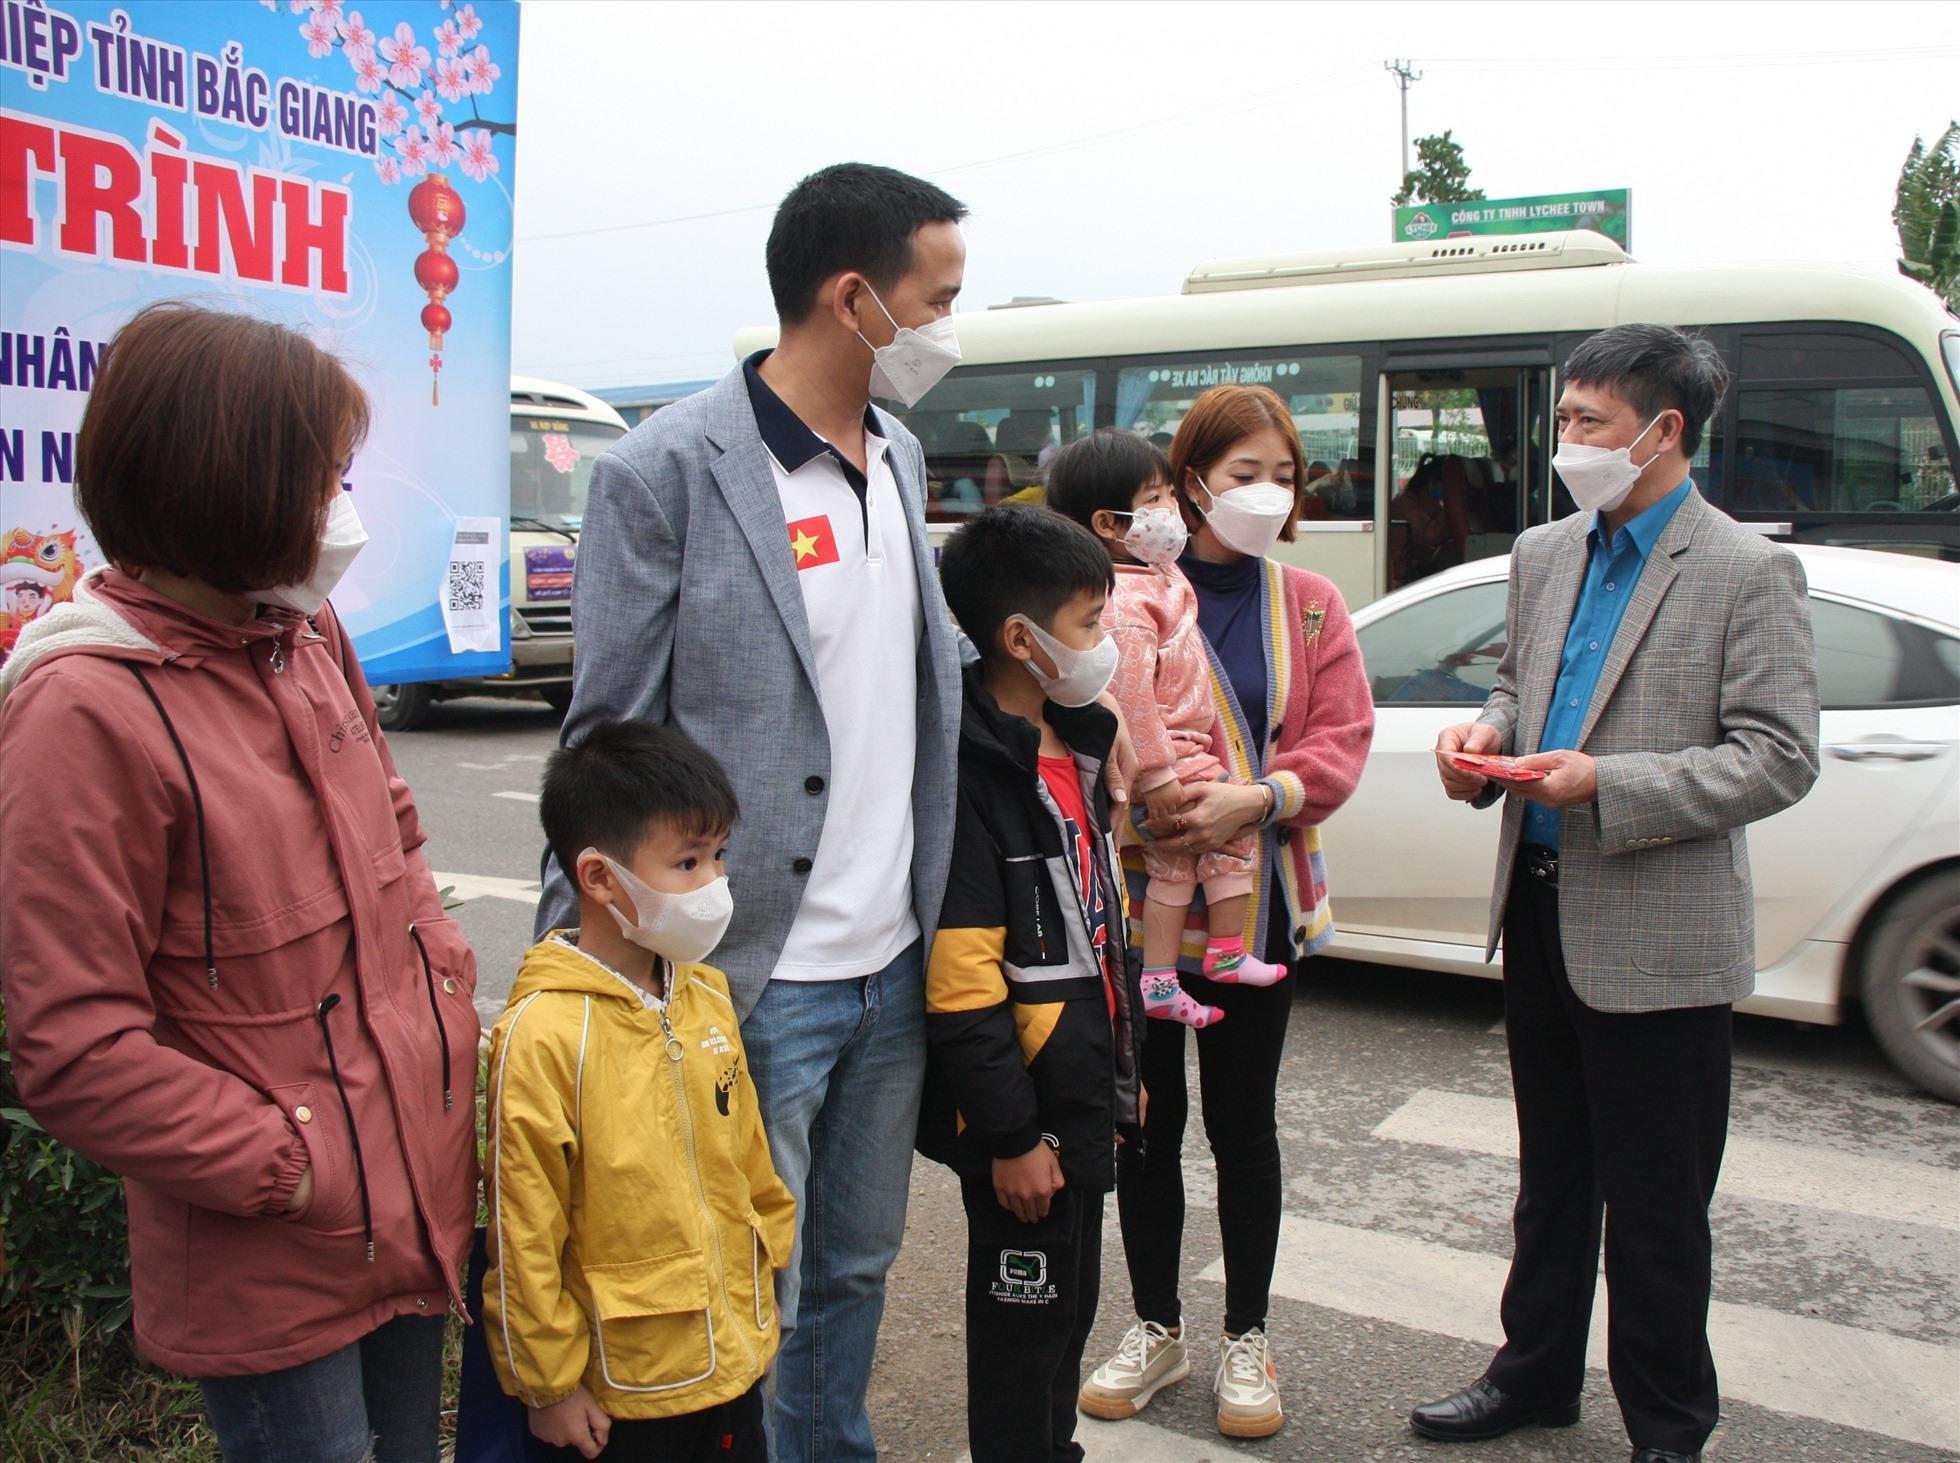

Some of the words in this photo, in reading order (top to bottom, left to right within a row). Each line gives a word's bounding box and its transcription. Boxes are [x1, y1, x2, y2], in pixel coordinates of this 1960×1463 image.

[92, 15, 184, 108] TỈNH
[197, 46, 267, 128] BẮC
[280, 82, 377, 155] GIANG
[0, 115, 348, 294] TRÌNH
[1452, 208, 1480, 223] CÔNG
[1483, 211, 1495, 221] TY
[1499, 207, 1527, 220] TNHH
[1529, 204, 1570, 218] LYCHEE
[1573, 200, 1605, 214] TOWN
